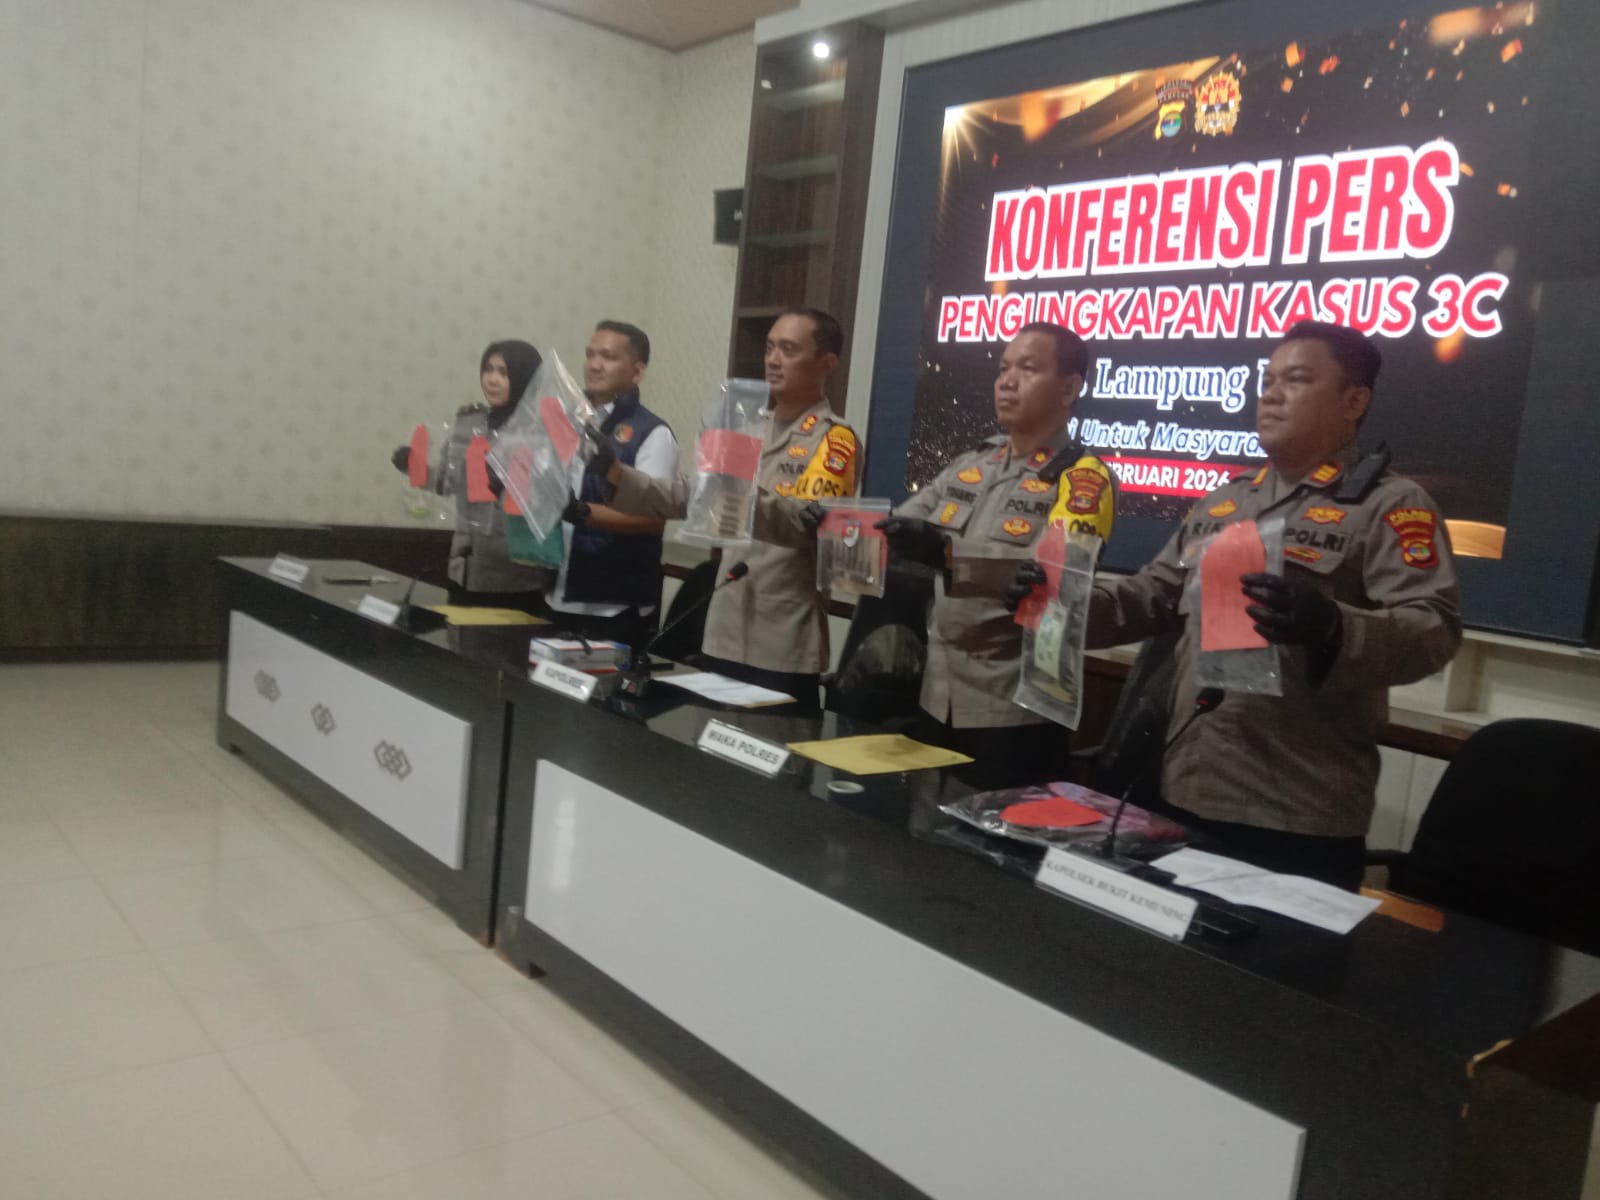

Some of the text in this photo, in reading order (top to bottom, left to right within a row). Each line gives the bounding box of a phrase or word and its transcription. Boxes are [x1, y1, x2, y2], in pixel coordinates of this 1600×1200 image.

[985, 139, 1459, 281] KONFERENSI PERS
[938, 272, 1509, 343] PENGUNGKAPAN KASUS 3C
[1093, 358, 1249, 412] Lampung
[1081, 417, 1150, 450] Untuk
[1151, 421, 1268, 460] Masyara
[1108, 461, 1180, 488] BRUARI
[1285, 527, 1345, 552] POLRI
[738, 740, 780, 765] POLRES
